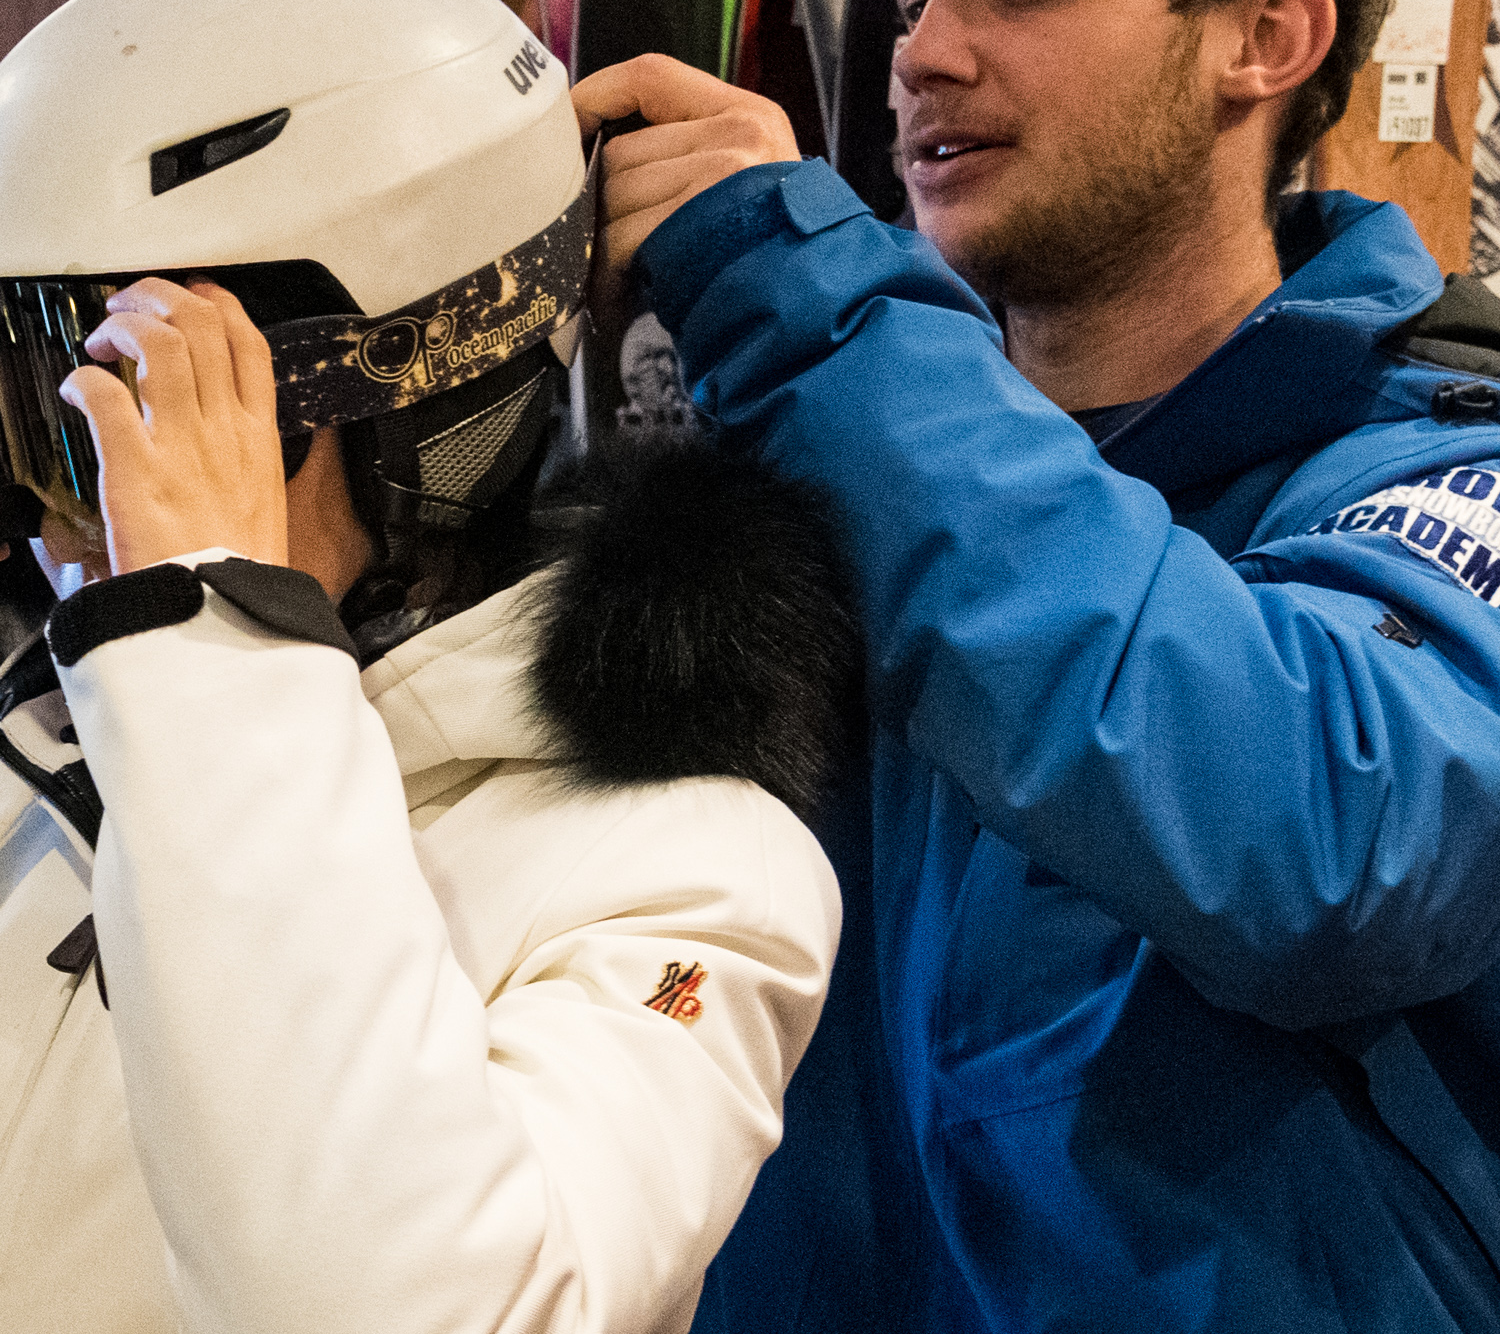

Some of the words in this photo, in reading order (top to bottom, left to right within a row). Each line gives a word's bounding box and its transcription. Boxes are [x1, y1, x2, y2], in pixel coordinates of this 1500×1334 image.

[503, 38, 549, 96] uve
[447, 328, 504, 368] ocean
[501, 293, 558, 351] pacific
